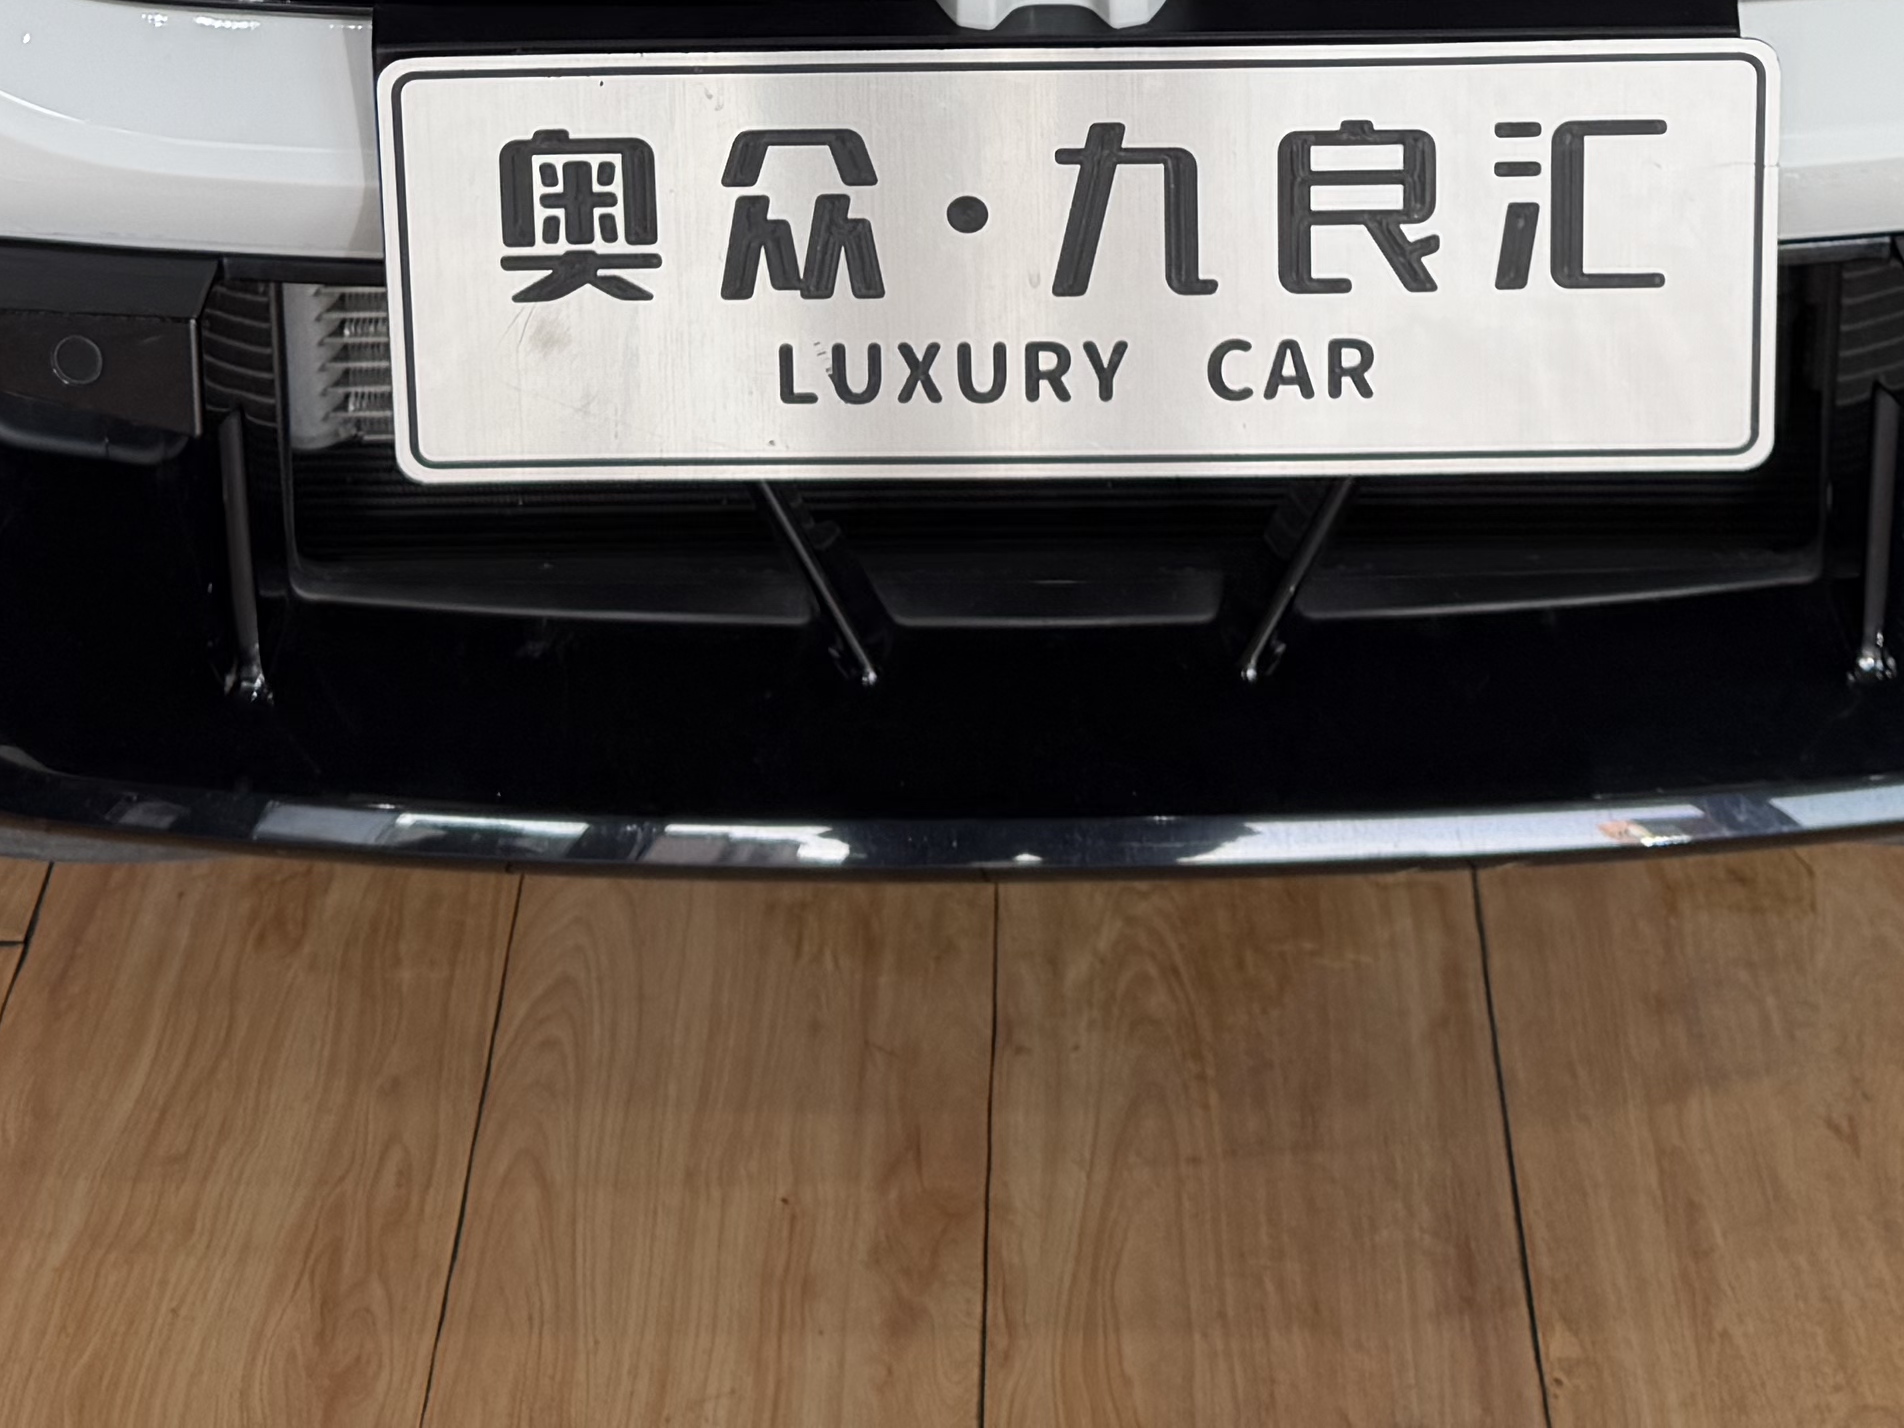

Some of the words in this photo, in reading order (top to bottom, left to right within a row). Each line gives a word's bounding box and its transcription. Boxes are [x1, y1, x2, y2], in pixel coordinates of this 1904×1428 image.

[498, 120, 1668, 302] 奥众·九良汇
[778, 340, 1129, 405] LUXURY
[1207, 338, 1377, 402] CAR
